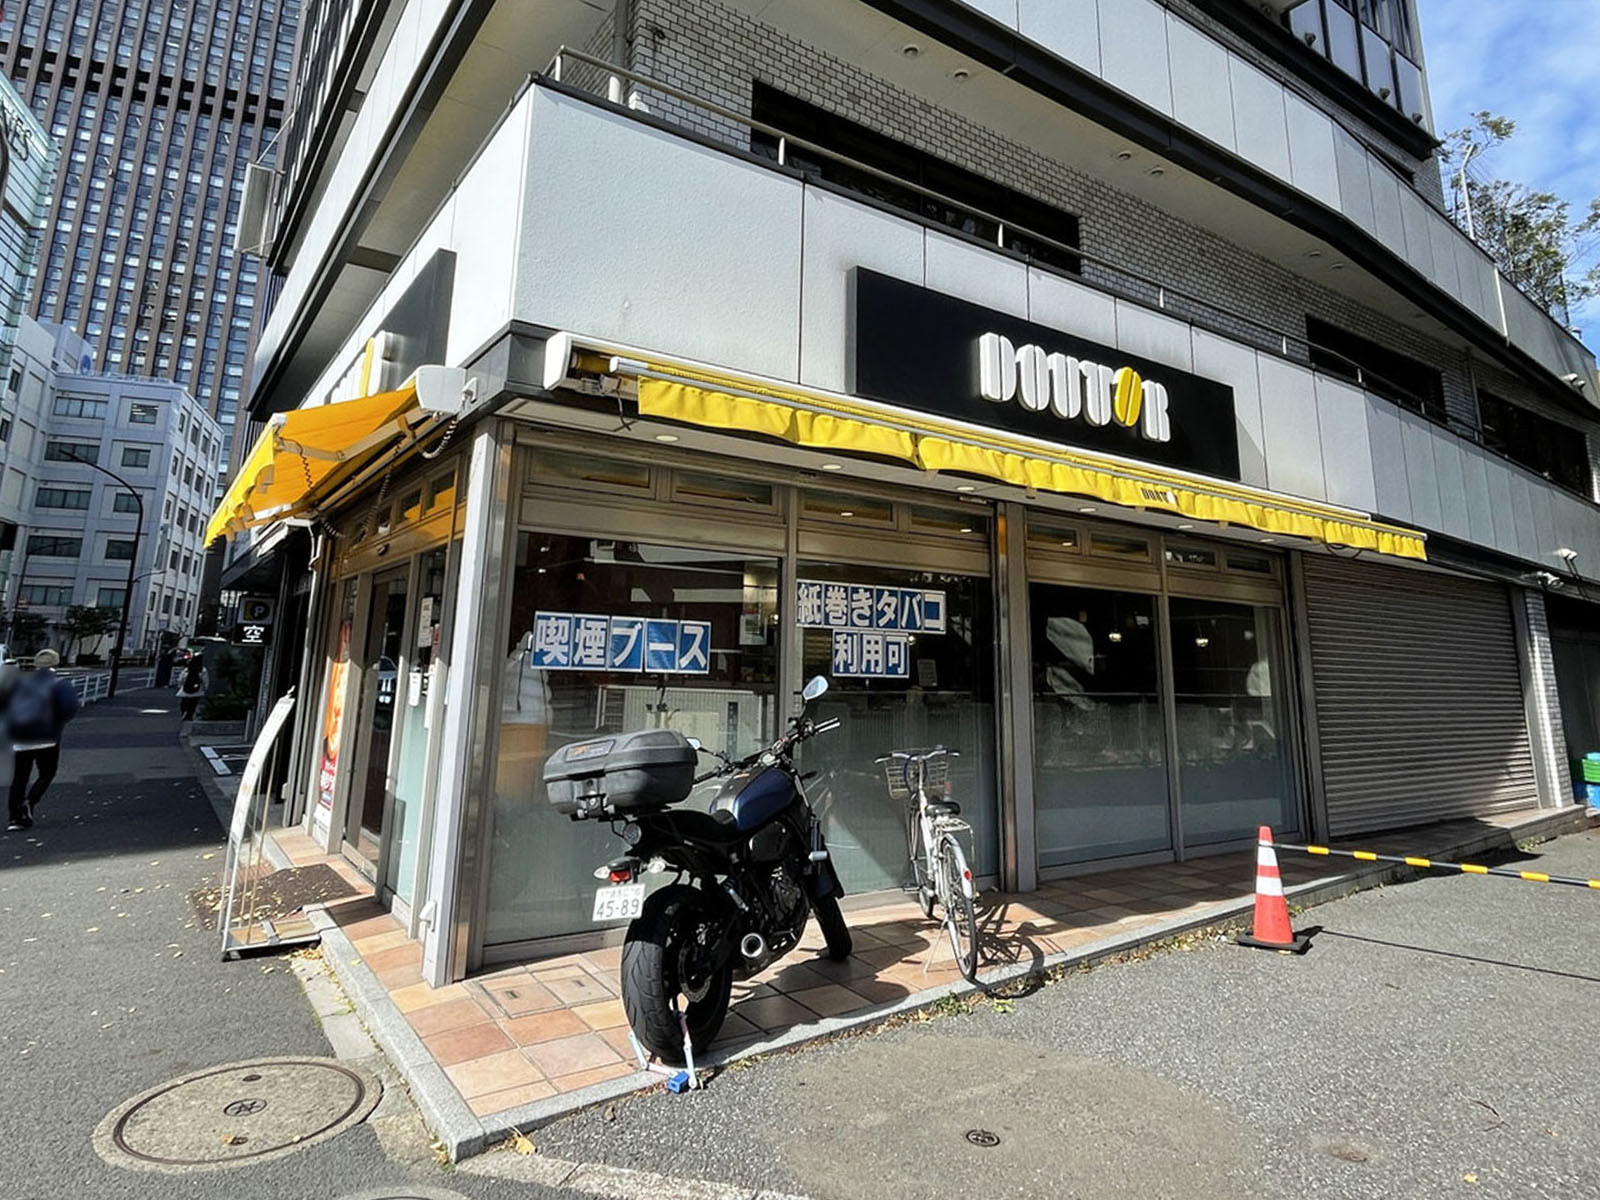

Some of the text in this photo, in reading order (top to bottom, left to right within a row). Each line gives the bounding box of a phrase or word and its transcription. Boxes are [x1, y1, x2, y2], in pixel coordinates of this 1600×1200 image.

[979, 332, 1171, 442] DOUTOR
[797, 582, 945, 631] 紙巻きタバコ
[241, 625, 264, 643] 空
[535, 616, 708, 669] 喫煙ブース
[834, 633, 910, 675] 利用可
[596, 898, 640, 919] 45-89
